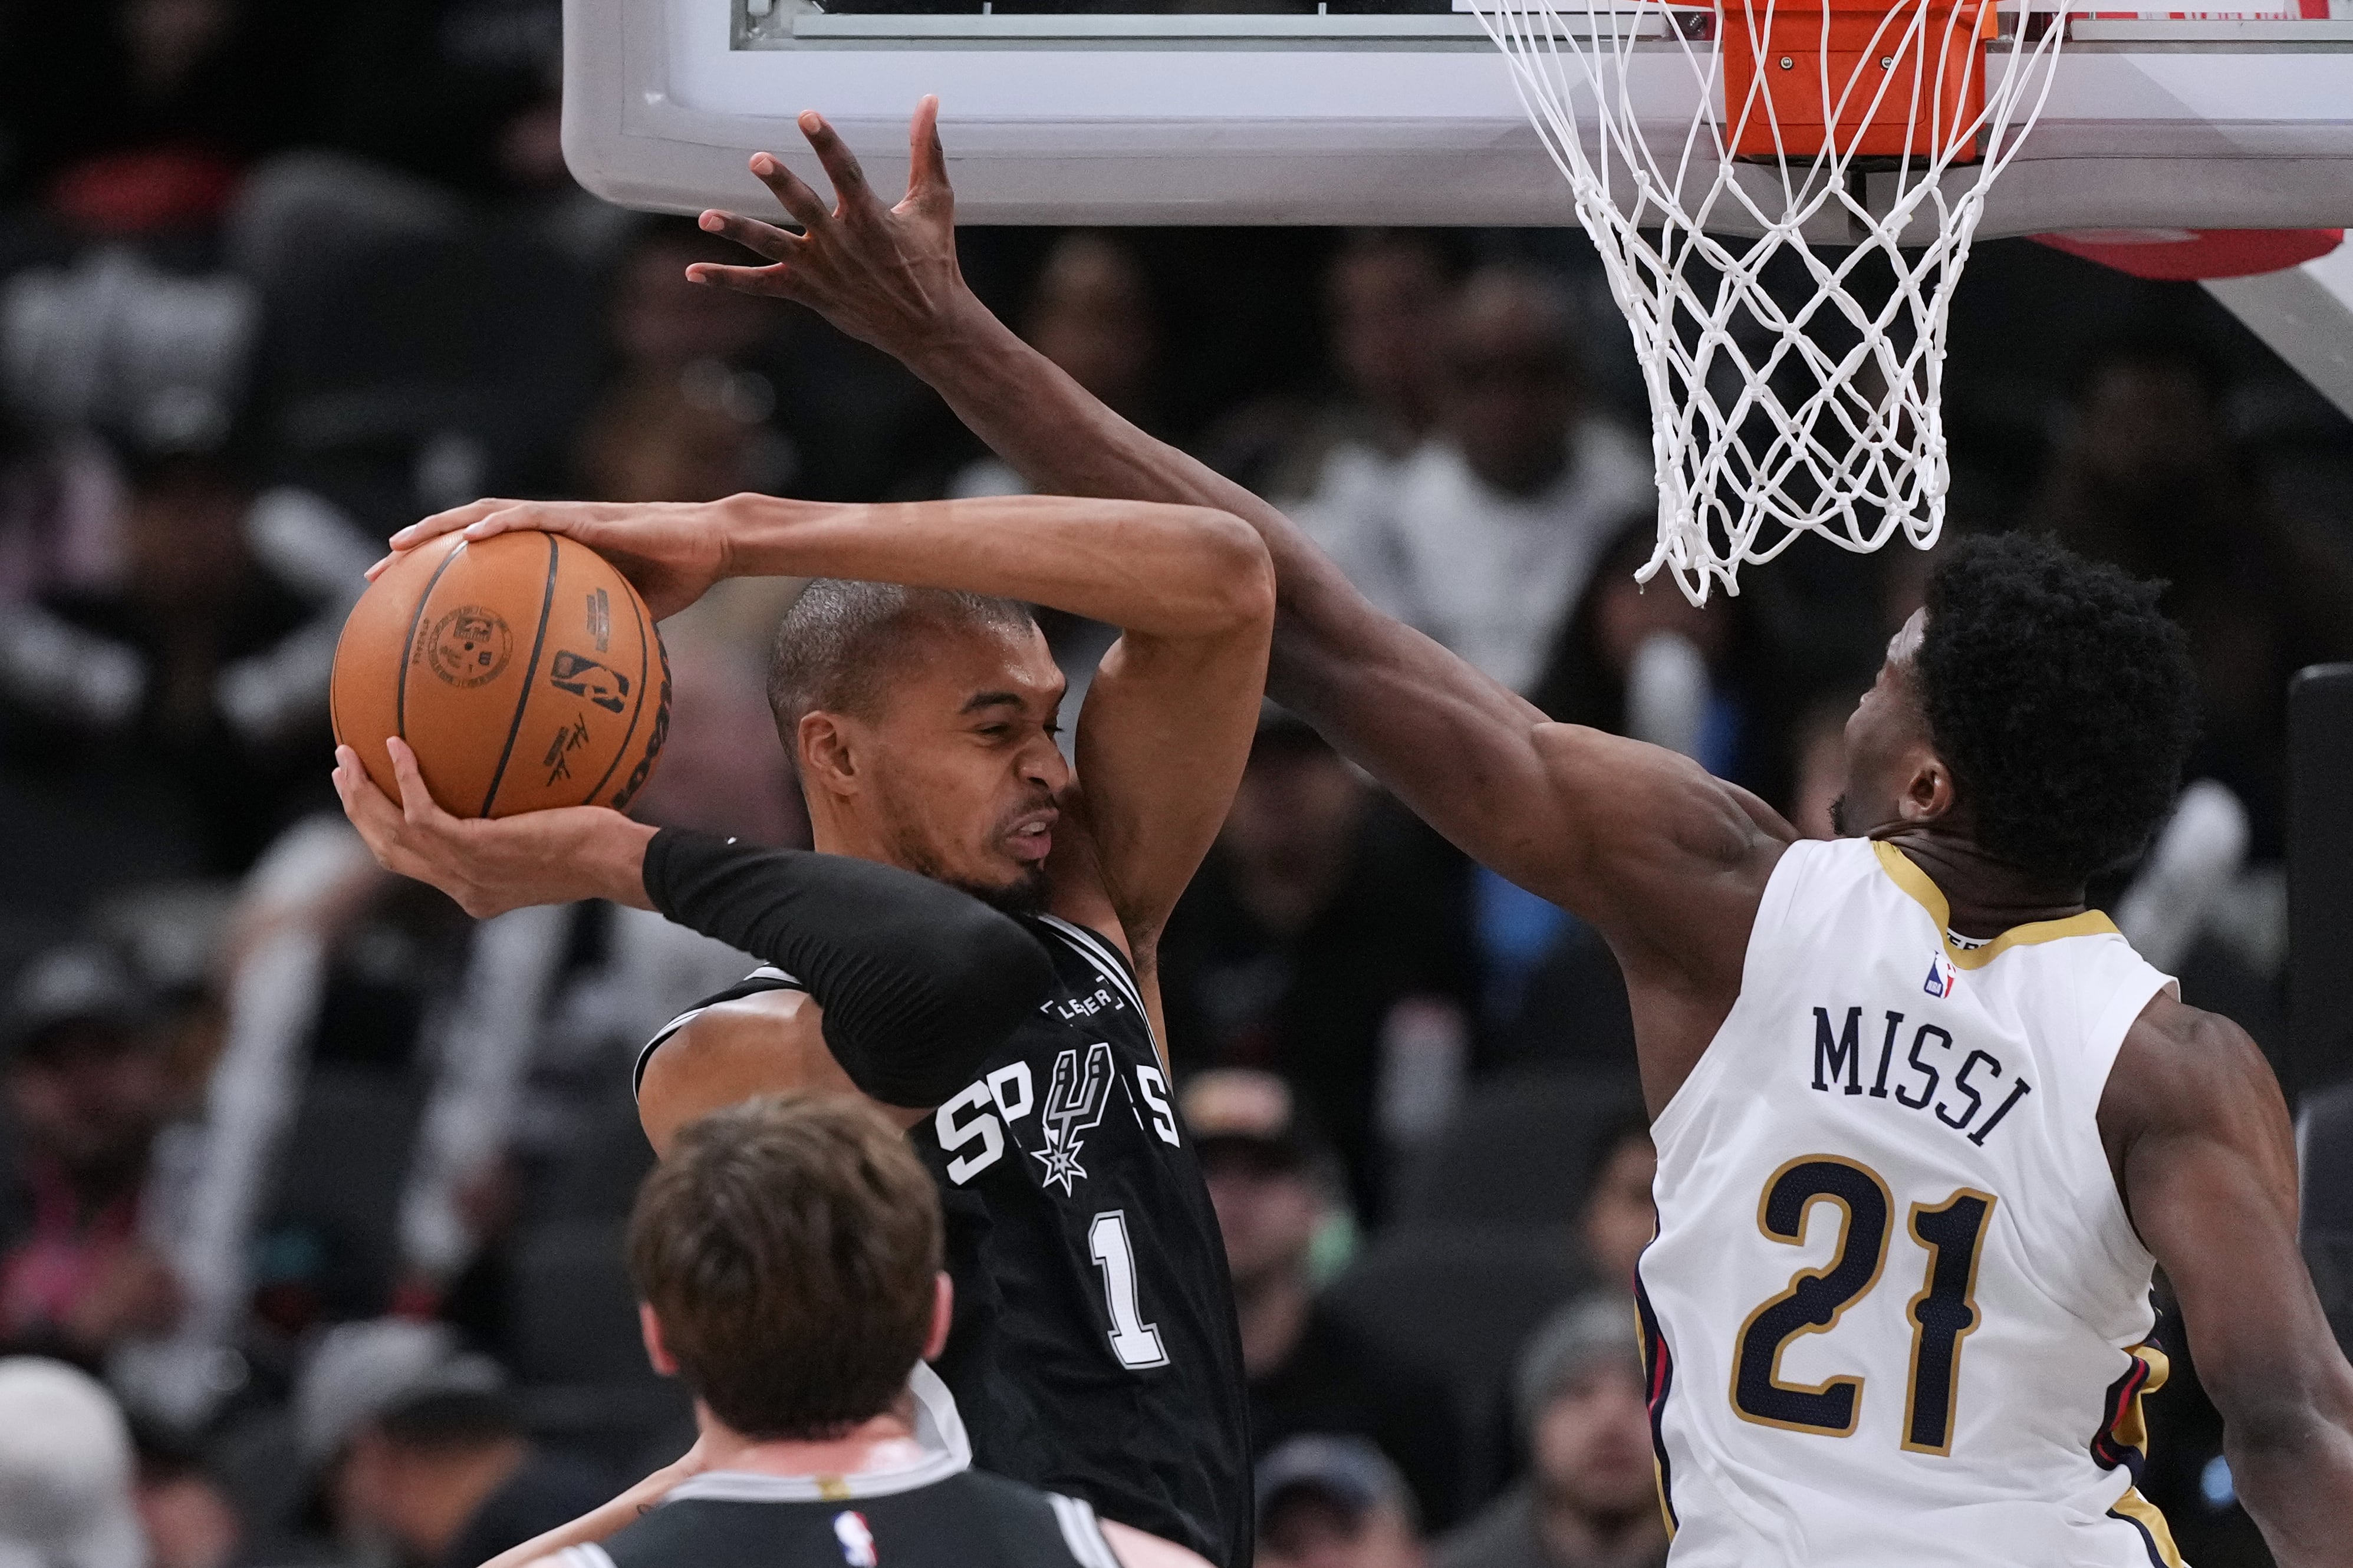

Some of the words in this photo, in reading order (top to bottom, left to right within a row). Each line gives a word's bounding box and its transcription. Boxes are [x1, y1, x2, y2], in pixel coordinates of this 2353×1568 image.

[1057, 989, 1112, 1020] LEER
[1926, 979, 1942, 994] NBA
[1811, 1006, 2032, 1148] MISSI
[1088, 1208, 1171, 1370] 1
[1729, 1153, 1998, 1457] 21
